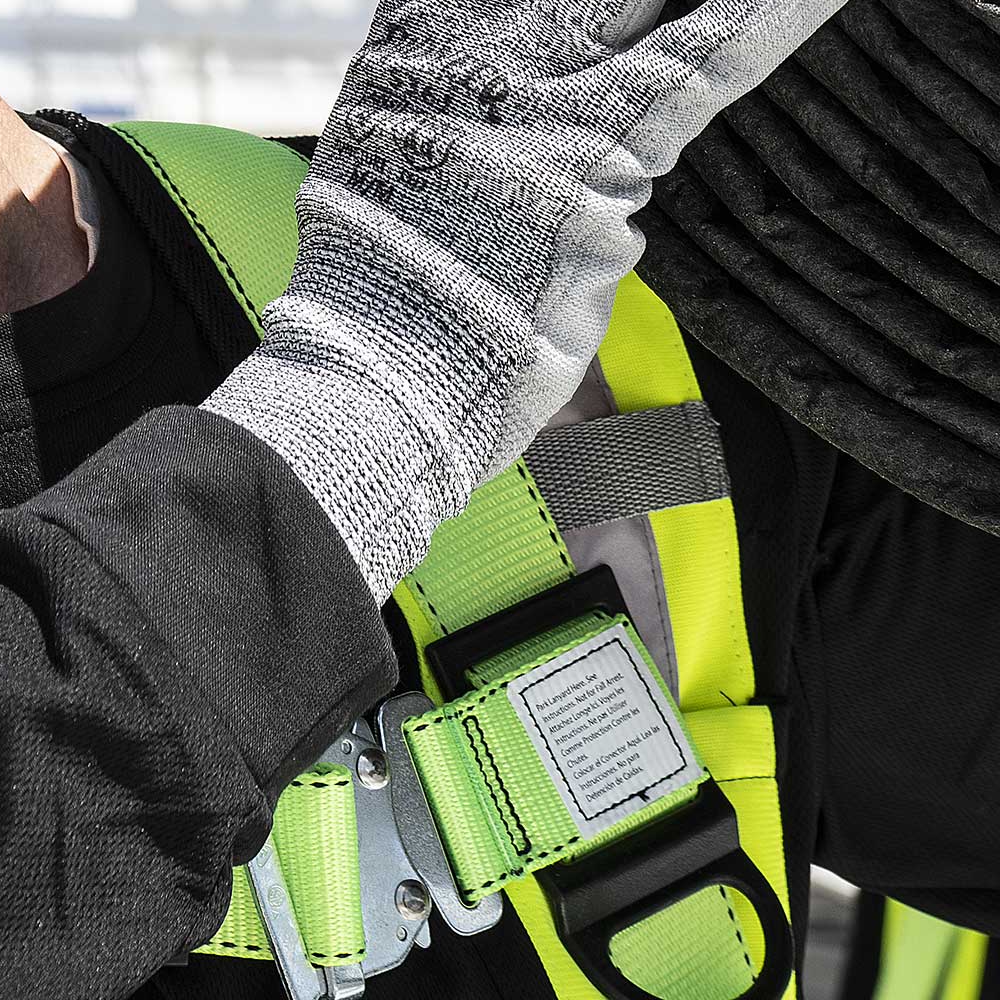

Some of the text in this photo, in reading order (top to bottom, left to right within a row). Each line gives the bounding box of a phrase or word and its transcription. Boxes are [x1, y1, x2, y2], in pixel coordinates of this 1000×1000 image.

[535, 700, 549, 712] Park
[546, 686, 572, 705] Lanyard
[585, 673, 598, 683] See
[574, 693, 588, 704] Not
[585, 688, 596, 697] for
[594, 681, 607, 692] Fall
[547, 717, 574, 734] Attachez
[570, 706, 592, 721] Longe
[613, 687, 625, 695] les
[586, 717, 598, 726] Ne
[596, 711, 609, 722] pas
[560, 707, 640, 757] Comme Protection Contre les
[573, 764, 595, 780] Colocar
[595, 758, 602, 767] el
[600, 744, 627, 764] Conector
[639, 729, 653, 740] Lea
[650, 725, 660, 734] las
[615, 760, 627, 769] No
[626, 752, 640, 765] para
[615, 776, 624, 785] de
